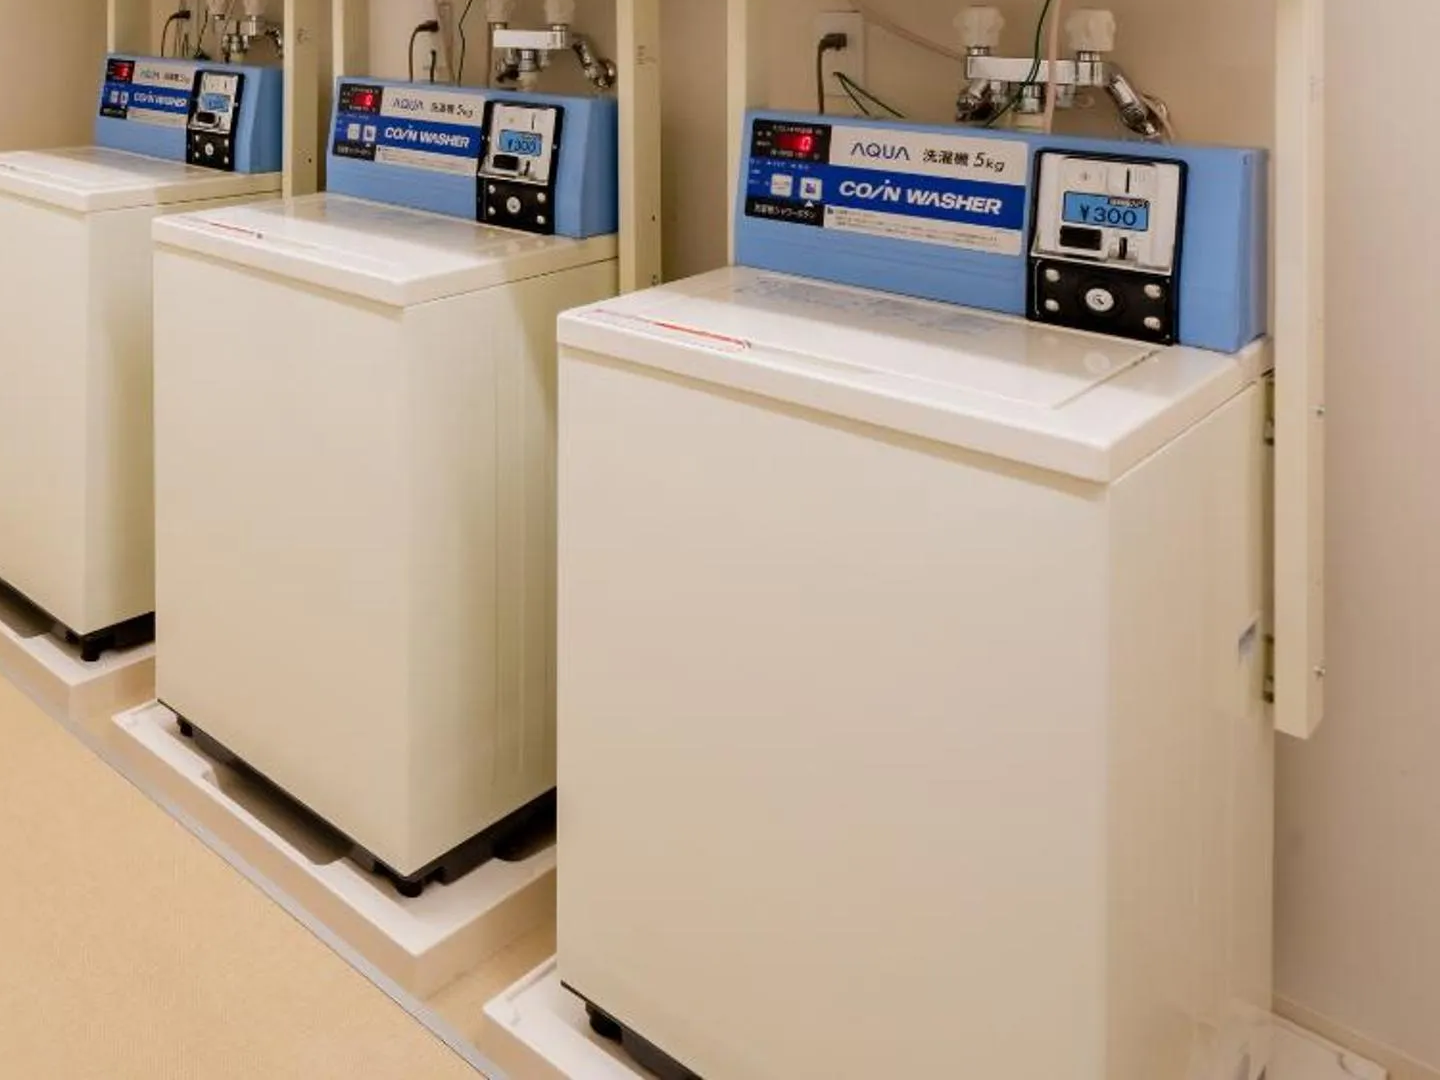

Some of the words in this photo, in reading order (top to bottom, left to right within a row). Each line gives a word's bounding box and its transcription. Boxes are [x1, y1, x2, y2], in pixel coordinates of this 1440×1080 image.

[384, 124, 417, 143] COIN
[419, 131, 470, 149] WASHER
[800, 135, 812, 152] 0
[851, 142, 910, 161] AQUA
[973, 152, 1005, 173] 5kg
[839, 178, 901, 202] COIN
[906, 188, 1003, 215] WASHER
[1079, 204, 1138, 226] ¥300
